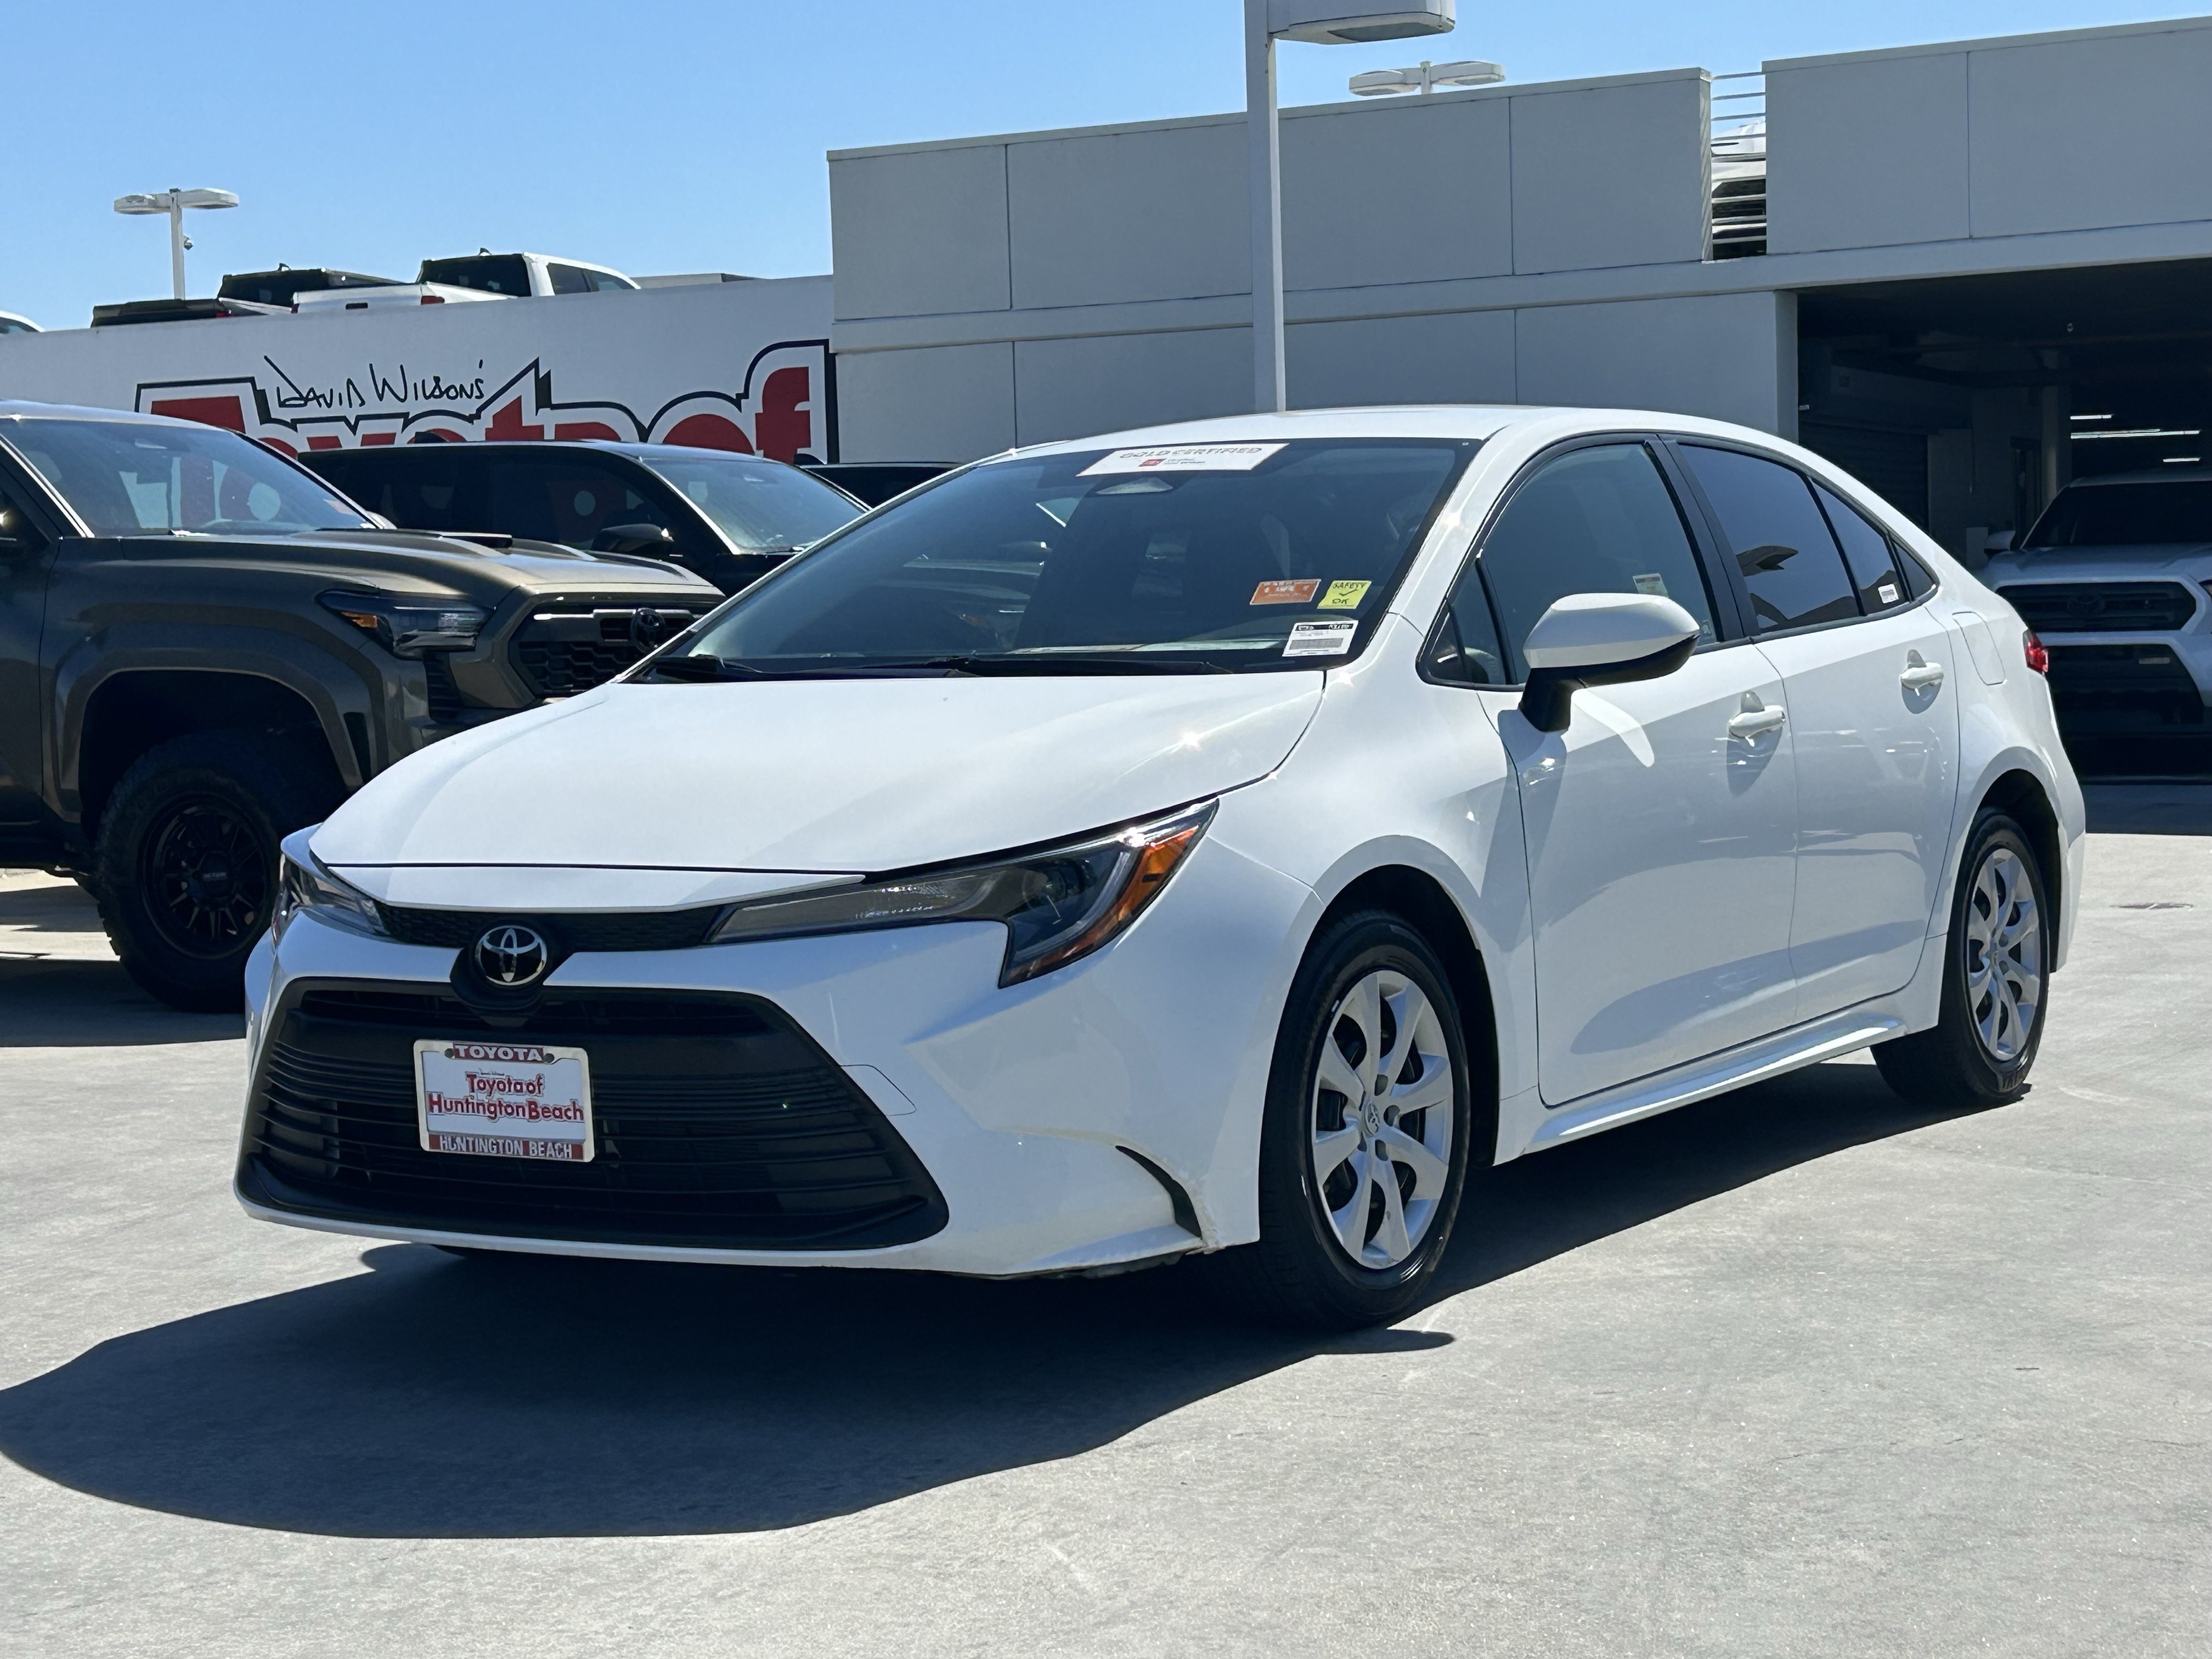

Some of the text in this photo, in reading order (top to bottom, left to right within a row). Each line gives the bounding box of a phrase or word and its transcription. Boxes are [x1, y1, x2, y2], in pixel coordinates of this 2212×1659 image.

[454, 1045, 543, 1062] TOYOTA
[466, 1073, 543, 1096] Toyota of
[428, 1093, 584, 1121] Huntington Beach
[439, 1135, 573, 1159] HUNTINGTON BEACH
